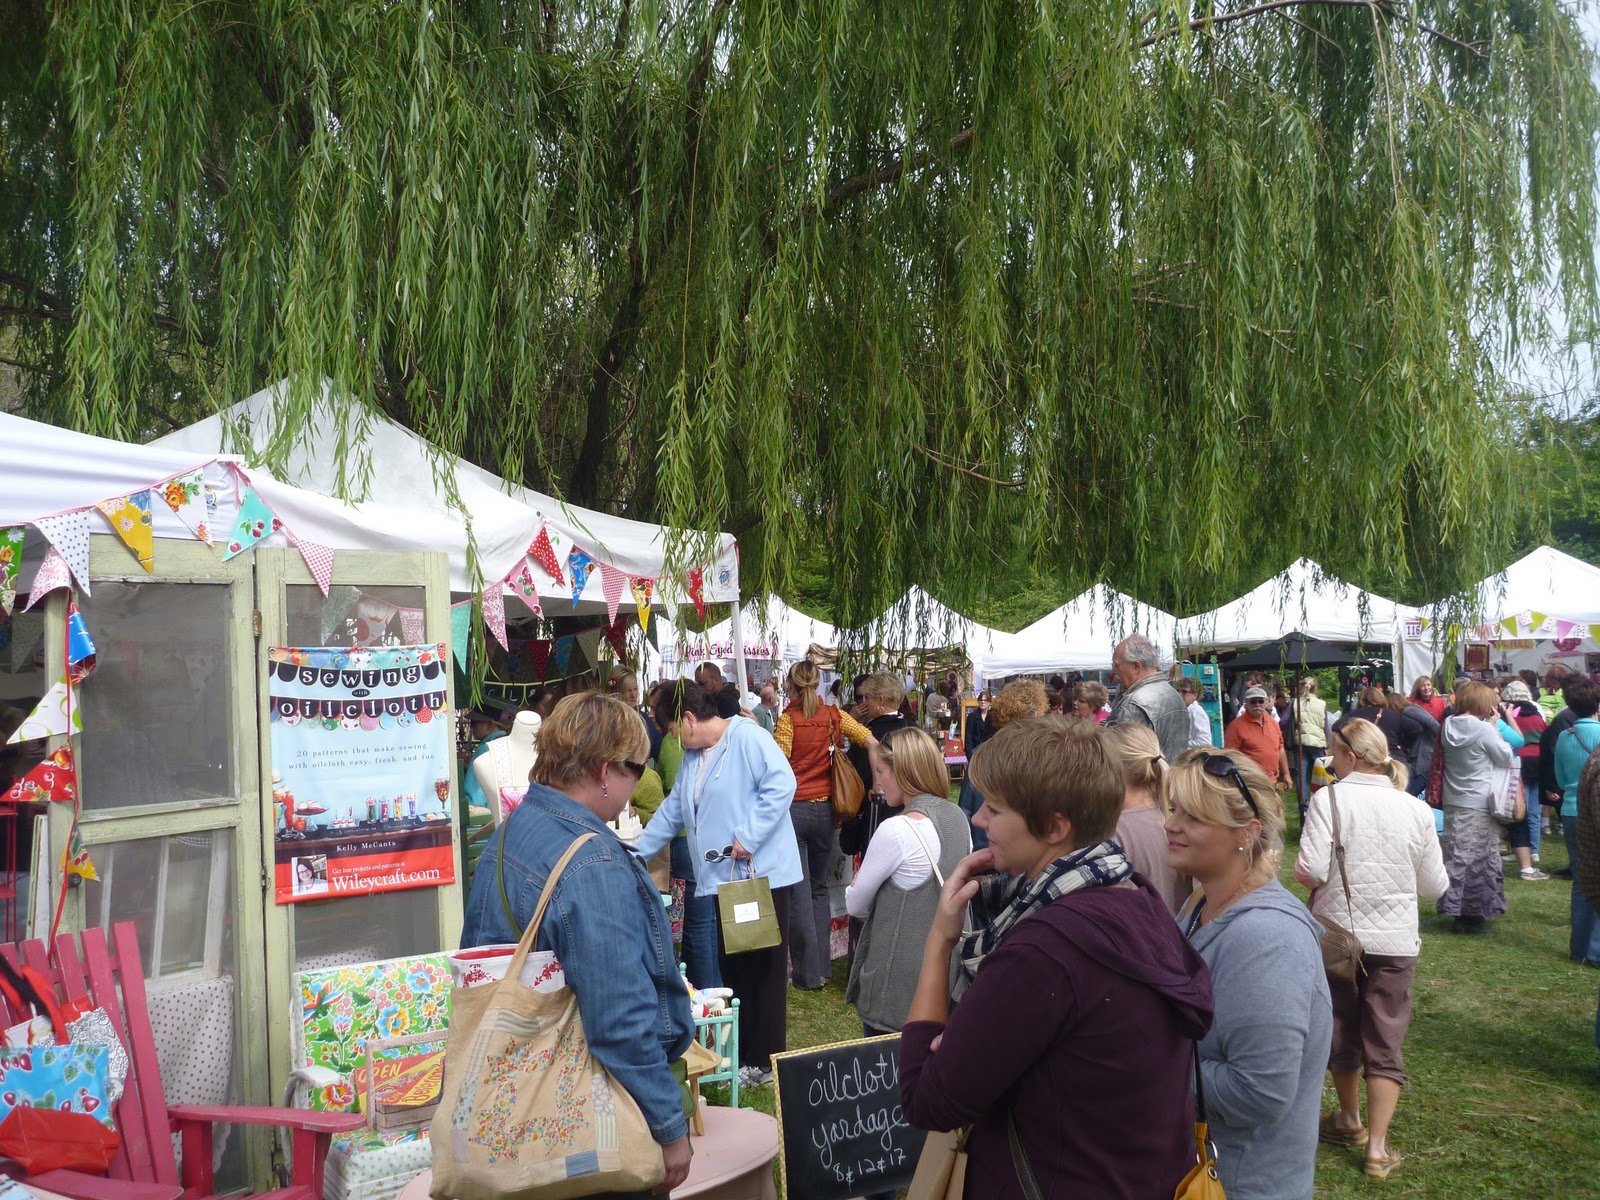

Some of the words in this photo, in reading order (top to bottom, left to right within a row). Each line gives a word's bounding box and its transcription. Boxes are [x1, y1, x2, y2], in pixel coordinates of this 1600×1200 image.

[1407, 625, 1420, 636] 116
[709, 642, 733, 659] Eyed
[742, 645, 770, 657] issies
[302, 666, 418, 687] sewing
[280, 693, 441, 718] oilcloth
[296, 750, 308, 758] 20
[312, 749, 349, 758] patterns
[398, 743, 427, 751] sewing
[312, 759, 346, 768] oilcloth
[336, 844, 358, 852] Kelly
[361, 840, 397, 849] McCants
[332, 867, 343, 875] Get
[352, 865, 372, 873] projects
[381, 862, 400, 870] patterns
[332, 867, 441, 892] Wileycraft.com
[811, 1104, 910, 1170] yardage
